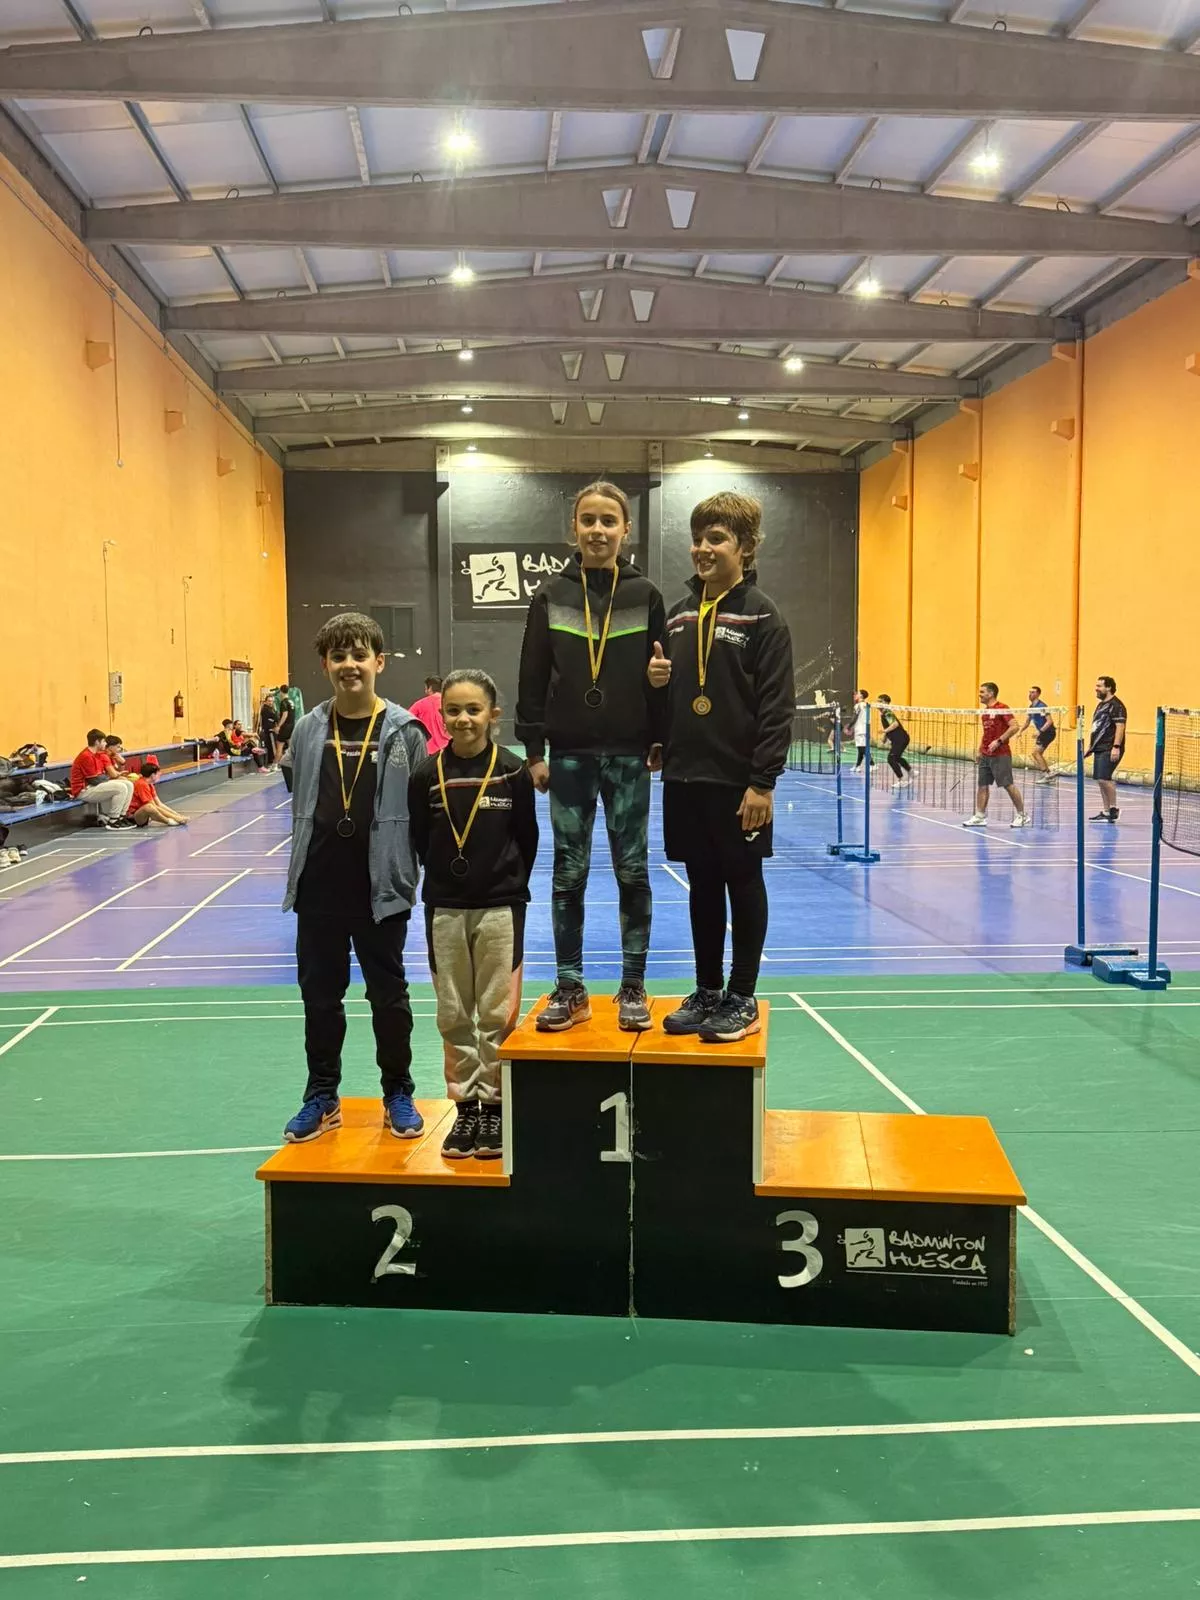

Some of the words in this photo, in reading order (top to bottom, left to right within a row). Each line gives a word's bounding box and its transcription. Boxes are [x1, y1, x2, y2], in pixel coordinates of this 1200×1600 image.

[600, 1091, 633, 1163] 1
[371, 1204, 417, 1279] 2
[775, 1210, 824, 1288] 3
[889, 1250, 987, 1275] HUESCA
